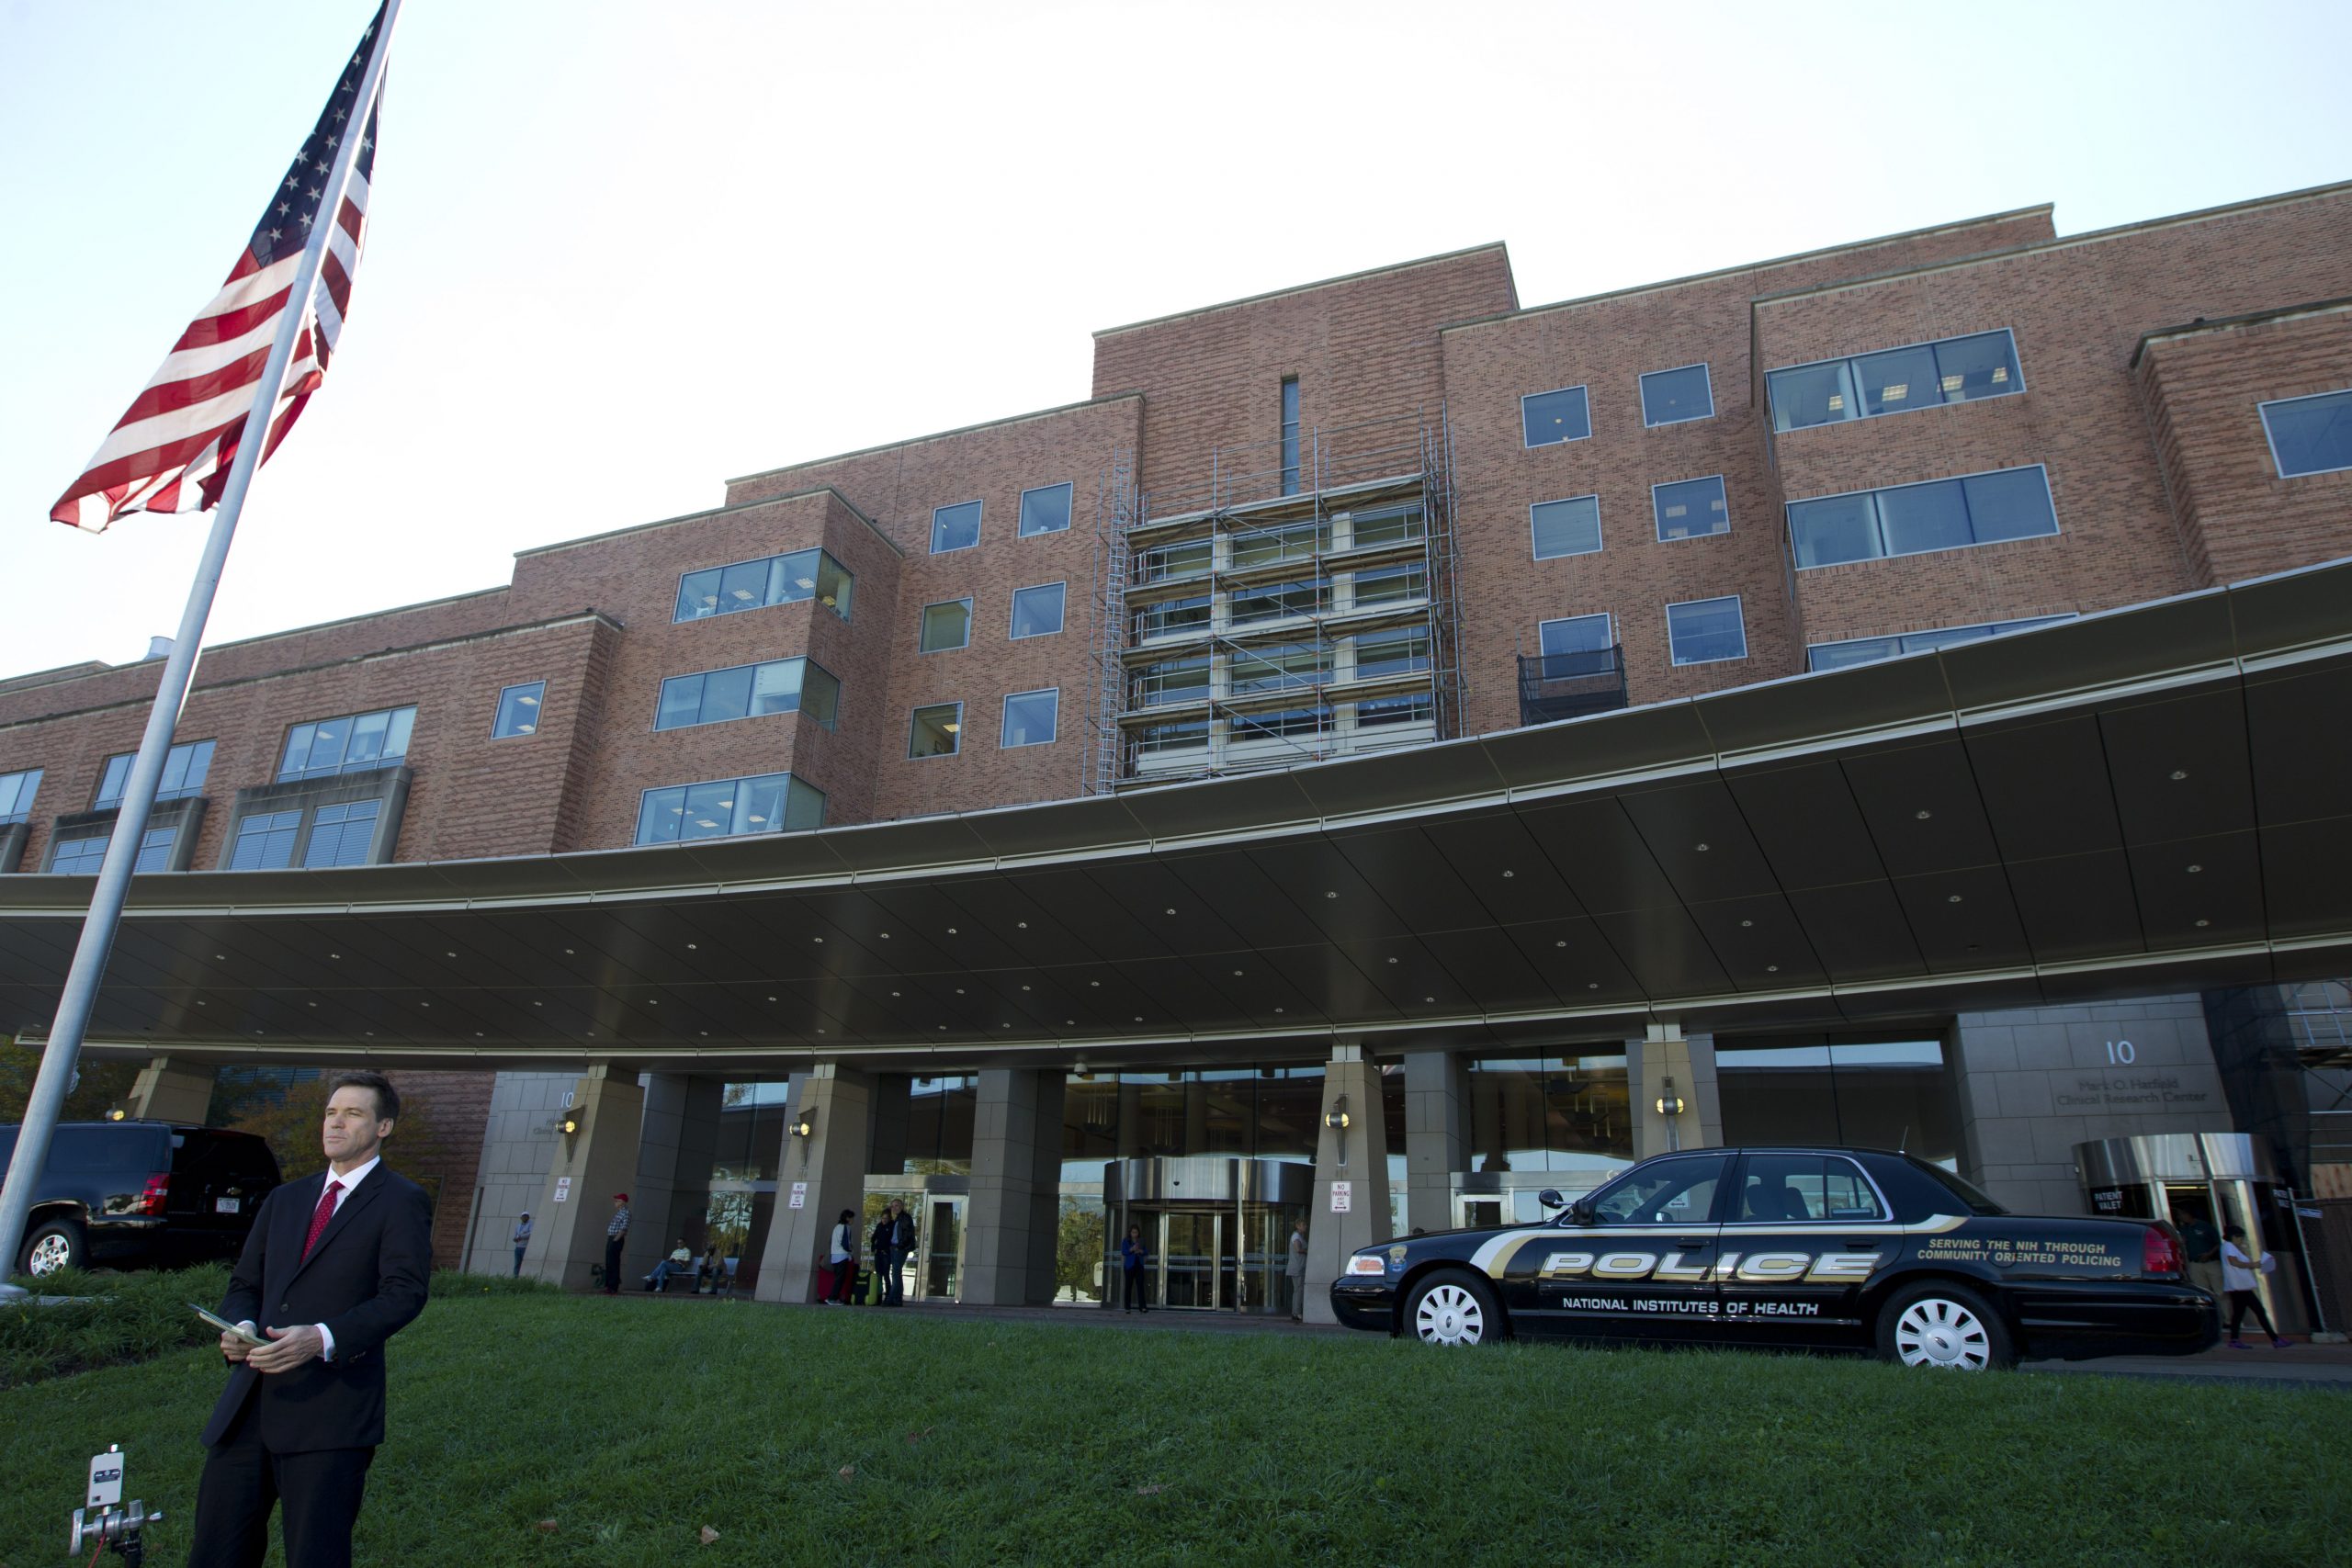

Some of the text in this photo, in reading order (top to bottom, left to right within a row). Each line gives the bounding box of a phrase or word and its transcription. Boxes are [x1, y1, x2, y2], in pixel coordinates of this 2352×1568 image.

[2107, 1040, 2135, 1065] 10
[2078, 1080, 2111, 1092] Mark
[560, 1091, 574, 1108] 10
[2057, 1090, 2208, 1106] Clinical Research Center
[2094, 1190, 2123, 1201] PATIENT
[2098, 1200, 2122, 1211] VALET
[1928, 1238, 2106, 1255] SERVING THE NIH THROUGH
[1917, 1249, 2121, 1267] COMMUNITY ORIENTED POLICING
[1539, 1252, 1883, 1282] POLICE
[1563, 1297, 1819, 1315] NATIONAL INSTITUTES OF HEALTH
